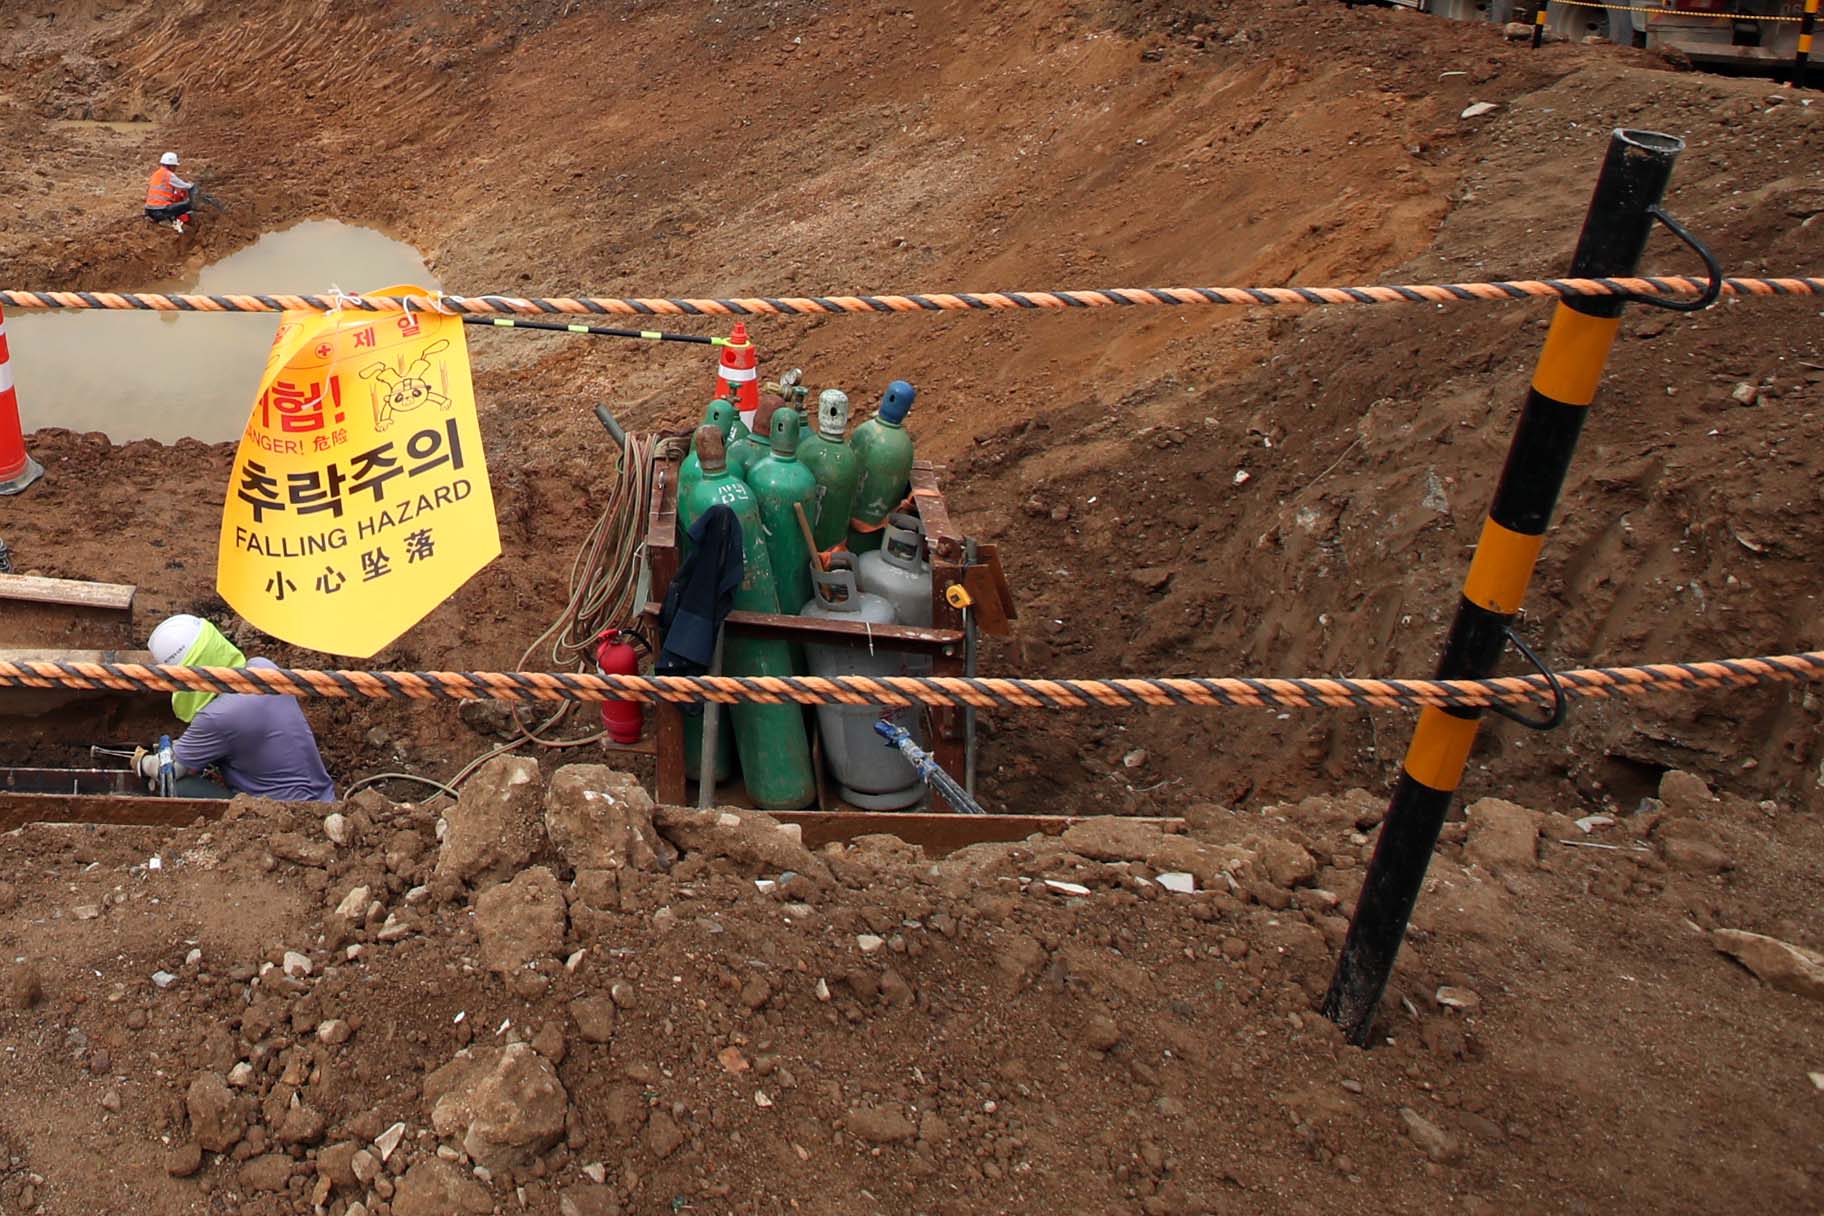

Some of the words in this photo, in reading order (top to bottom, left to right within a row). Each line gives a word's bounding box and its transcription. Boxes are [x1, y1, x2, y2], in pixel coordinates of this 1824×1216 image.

[237, 417, 465, 524] 추락주의
[246, 430, 305, 456] ANGER!
[236, 525, 348, 559] FALLING
[357, 478, 473, 541] HAZARD
[264, 527, 436, 602] 小心坠落
